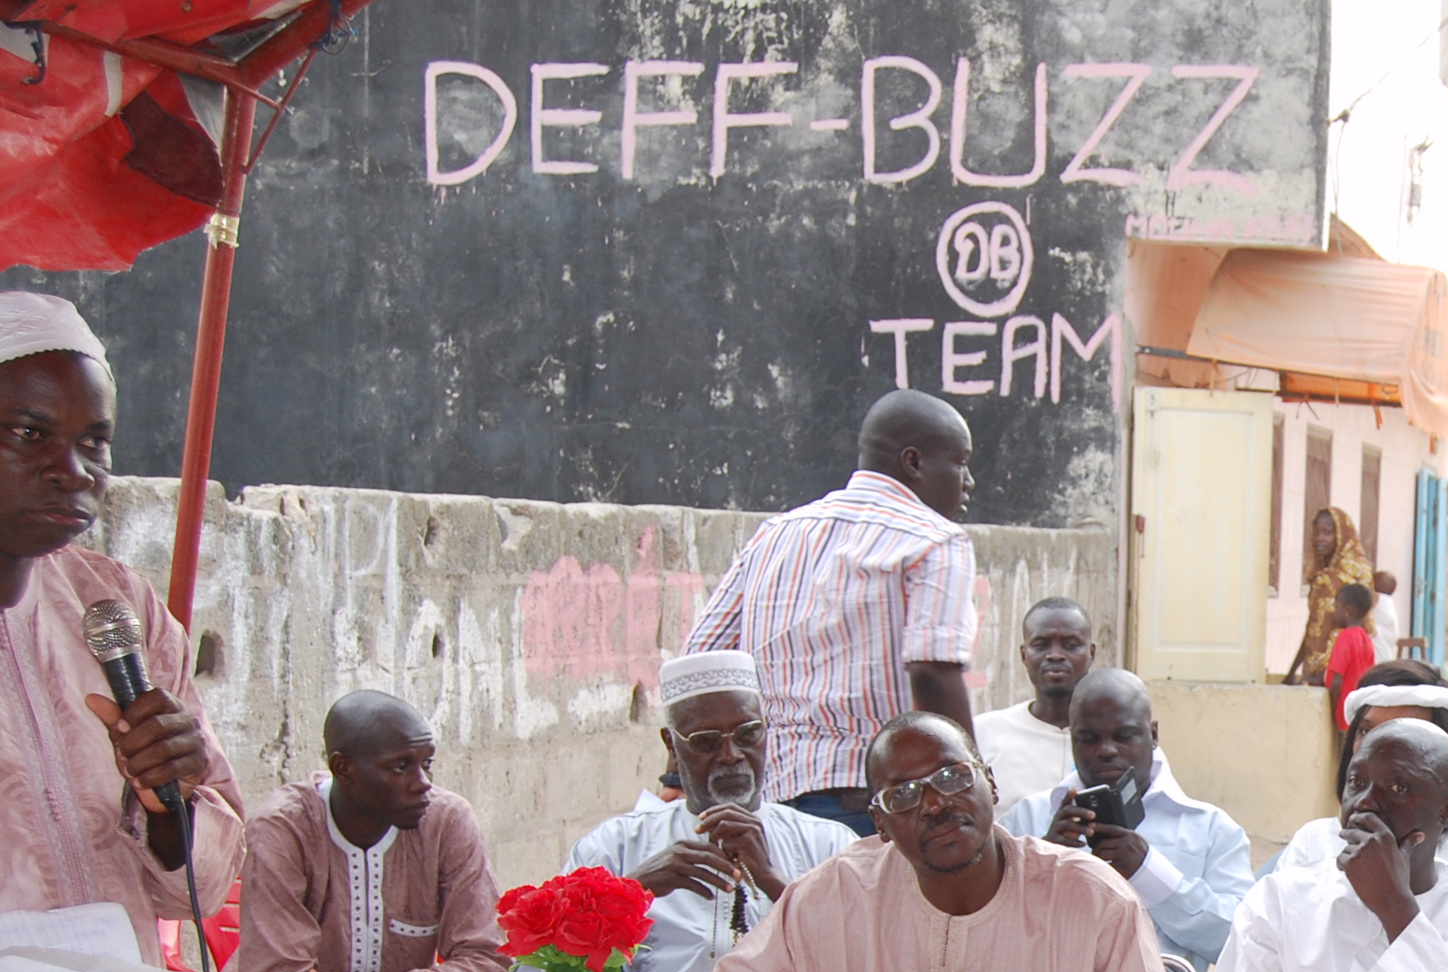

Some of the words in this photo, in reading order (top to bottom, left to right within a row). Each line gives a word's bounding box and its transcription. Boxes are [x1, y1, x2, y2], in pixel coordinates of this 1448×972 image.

[424, 56, 1262, 196] DEFF-BUZZ
[954, 221, 1020, 280] DB
[869, 311, 1124, 413] TEAM
